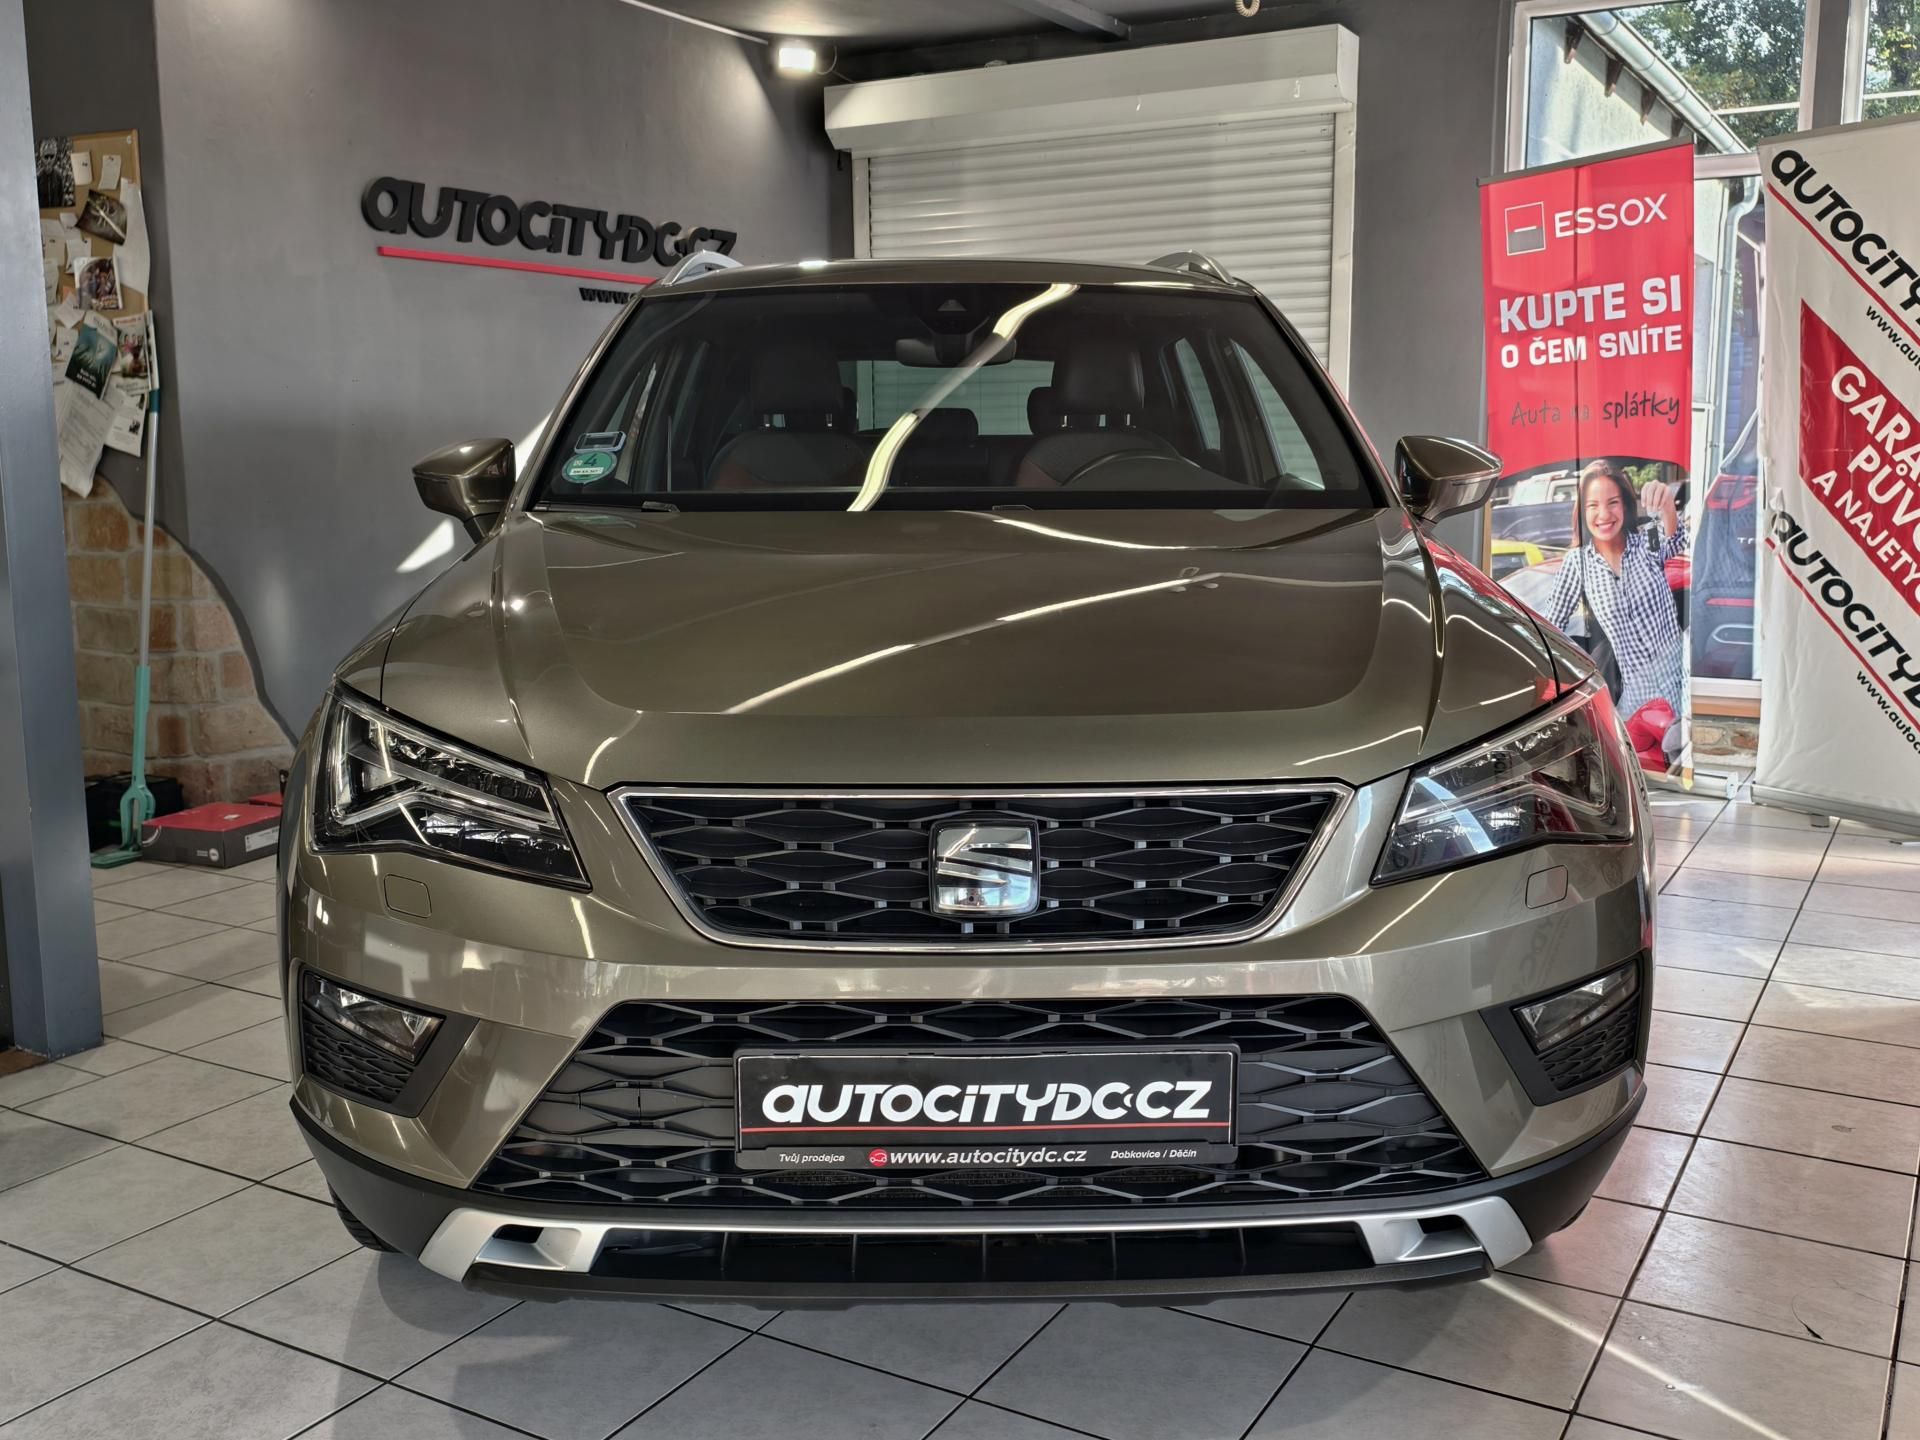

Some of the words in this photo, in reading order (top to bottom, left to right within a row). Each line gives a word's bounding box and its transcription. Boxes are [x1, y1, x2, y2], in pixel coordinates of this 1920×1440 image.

[1554, 193, 1667, 238] ESSOX
[1500, 283, 1626, 333] KUPTE
[1642, 275, 1682, 316] SI
[1501, 344, 1519, 369] O
[1529, 336, 1587, 367] ČEM
[1599, 323, 1682, 359] SNÍTE
[1511, 401, 1561, 426] Auta
[1603, 390, 1680, 428] splátky
[1812, 470, 1838, 497] A
[1834, 488, 1920, 604] NAJETY
[779, 1153, 800, 1165] Tvůj
[801, 1153, 845, 1164] prodejce
[890, 1147, 1087, 1167] www.autocitydc.cz
[1110, 1150, 1161, 1160] Dobkovice
[1169, 1149, 1197, 1159] Děčín
